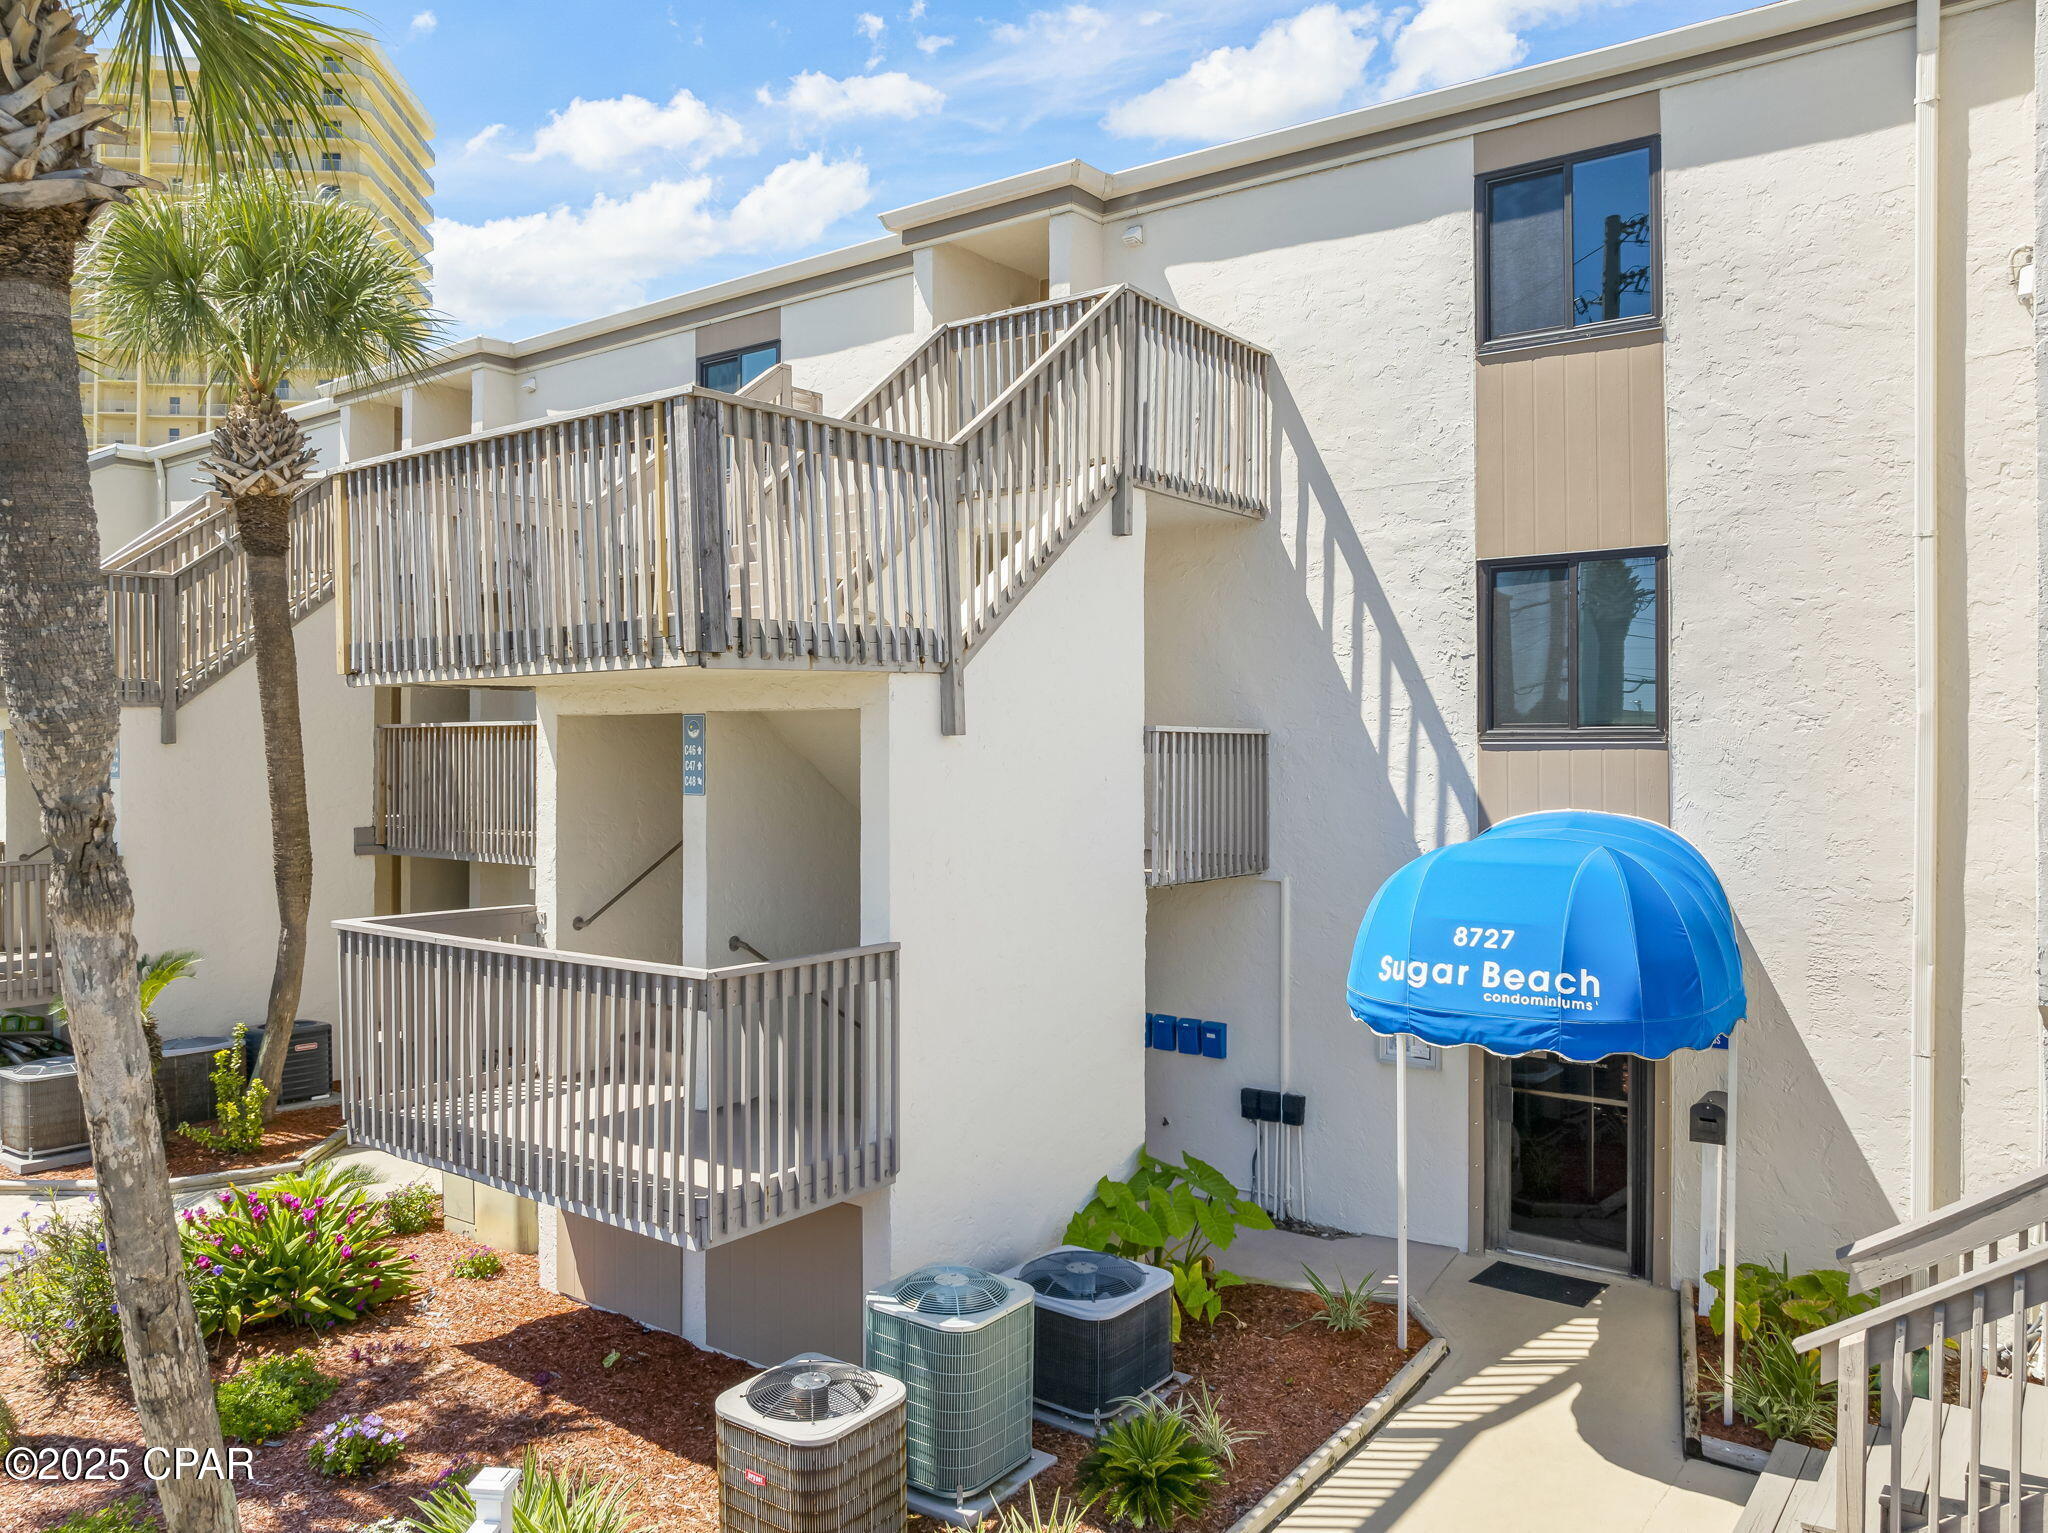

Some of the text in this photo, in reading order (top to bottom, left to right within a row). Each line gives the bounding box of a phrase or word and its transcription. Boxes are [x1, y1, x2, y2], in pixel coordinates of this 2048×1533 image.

[684, 744, 696, 756] C46
[685, 760, 696, 771] C47
[684, 775, 696, 787] C48
[1453, 926, 1515, 949] 8727
[1378, 955, 1600, 998] Sugar Beach
